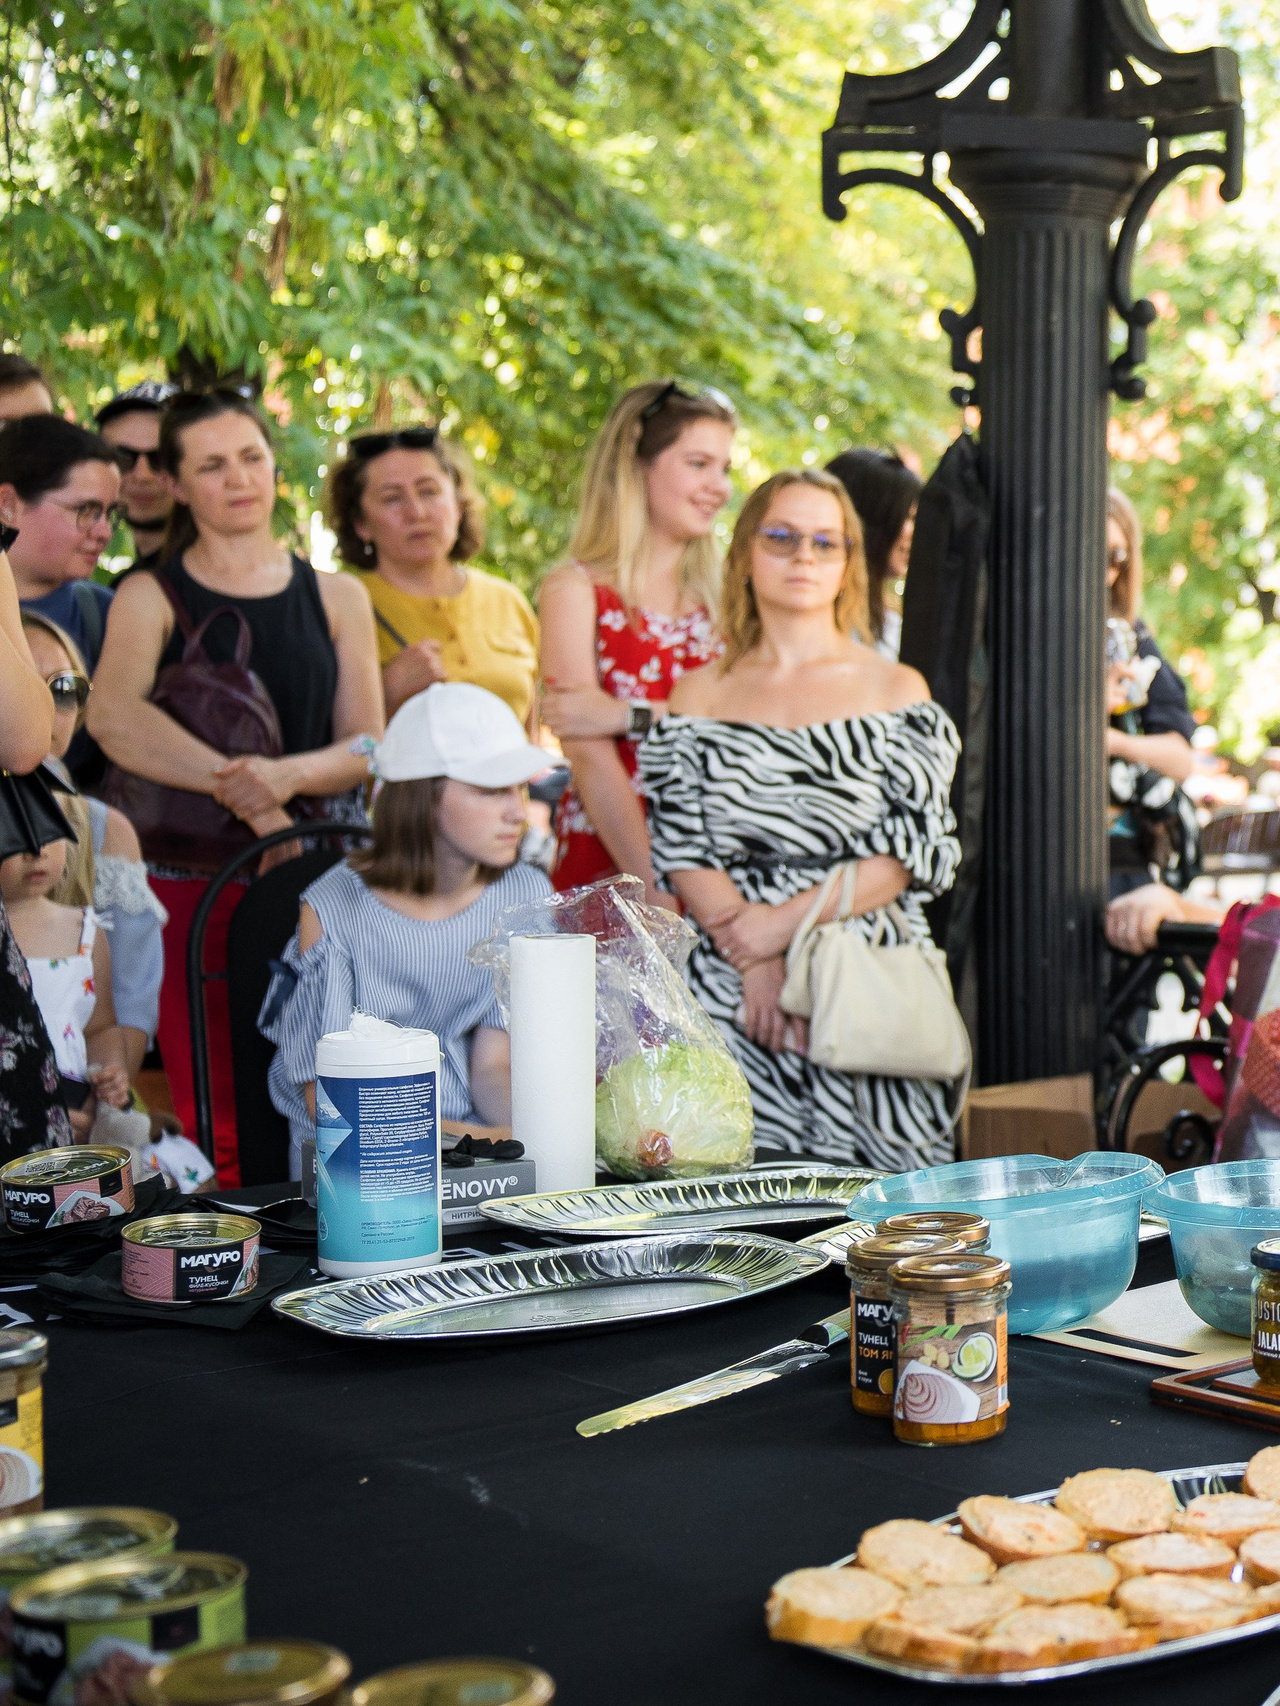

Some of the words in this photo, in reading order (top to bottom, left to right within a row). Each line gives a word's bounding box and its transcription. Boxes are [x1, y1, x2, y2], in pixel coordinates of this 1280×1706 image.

[442, 1176, 518, 1201] ENOVY®
[5, 1189, 51, 1205] МАГУРО
[180, 1250, 241, 1269] МАГУРО
[188, 1275, 218, 1284] ТУНЕЦ
[857, 1302, 894, 1322] МАГУ
[858, 1332, 889, 1347] ТУНЕЦ
[858, 1346, 879, 1359] ТОМ
